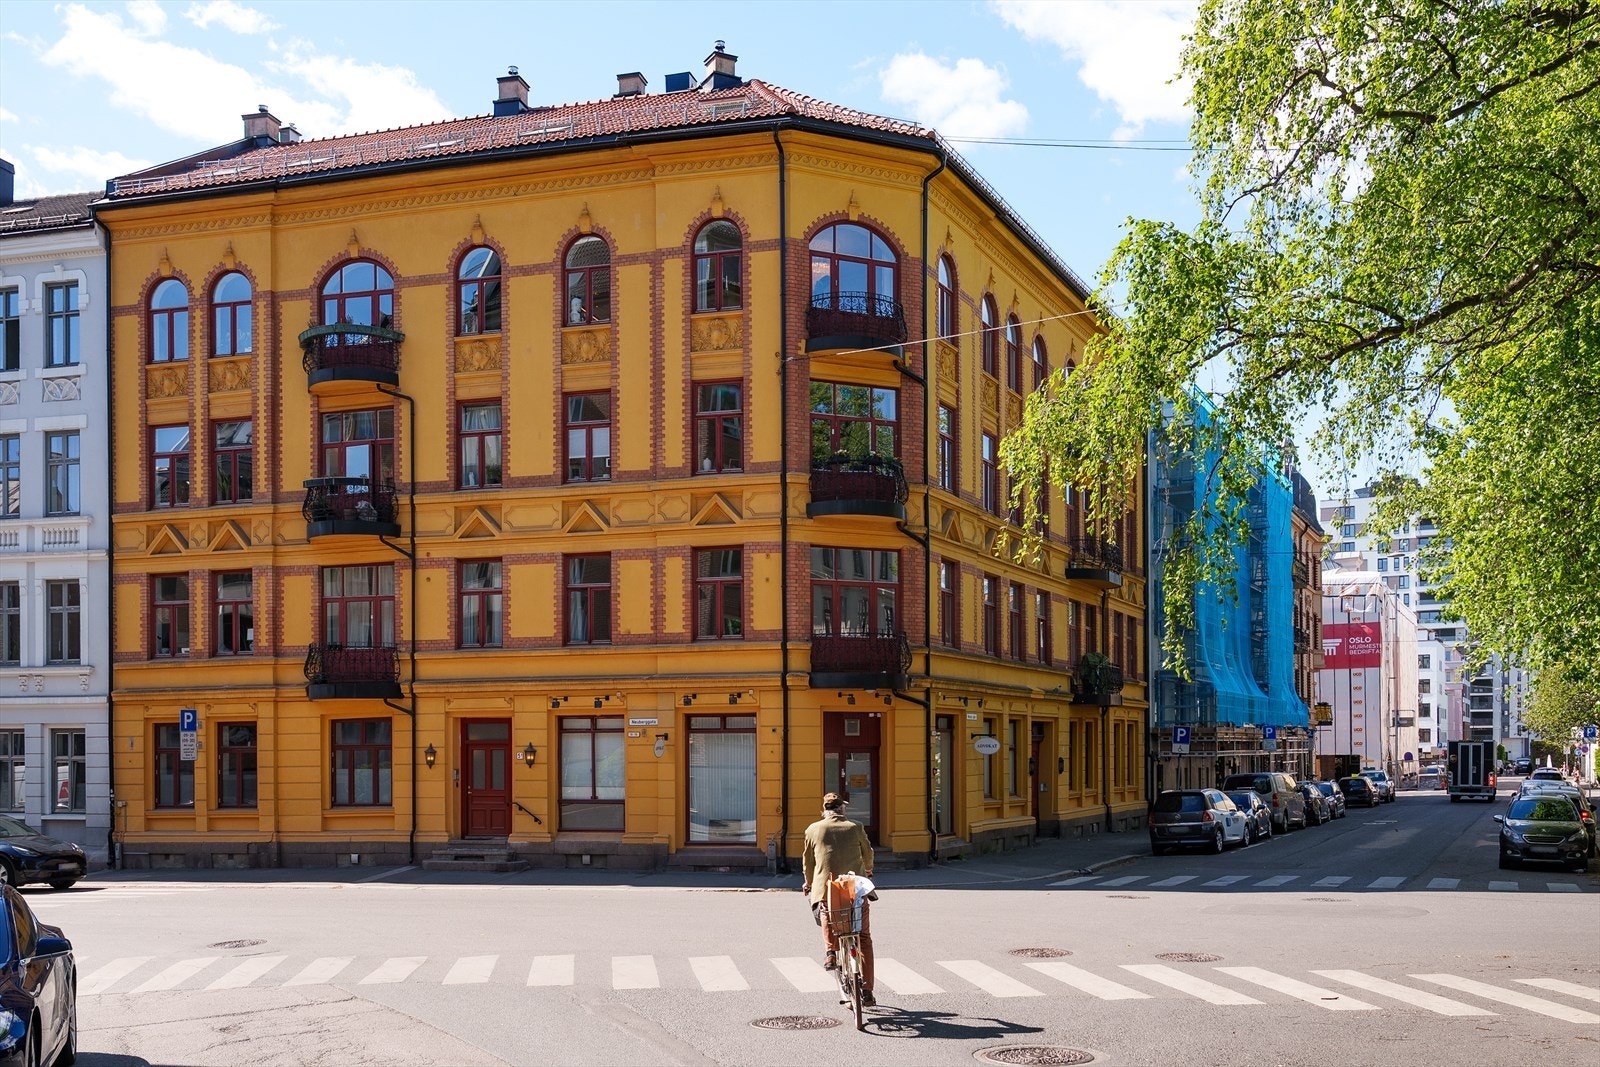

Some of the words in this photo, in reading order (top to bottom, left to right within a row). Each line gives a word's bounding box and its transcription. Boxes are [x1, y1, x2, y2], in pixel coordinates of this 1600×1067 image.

[184, 712, 193, 729] P
[1177, 728, 1187, 742] P
[1266, 727, 1273, 738] P
